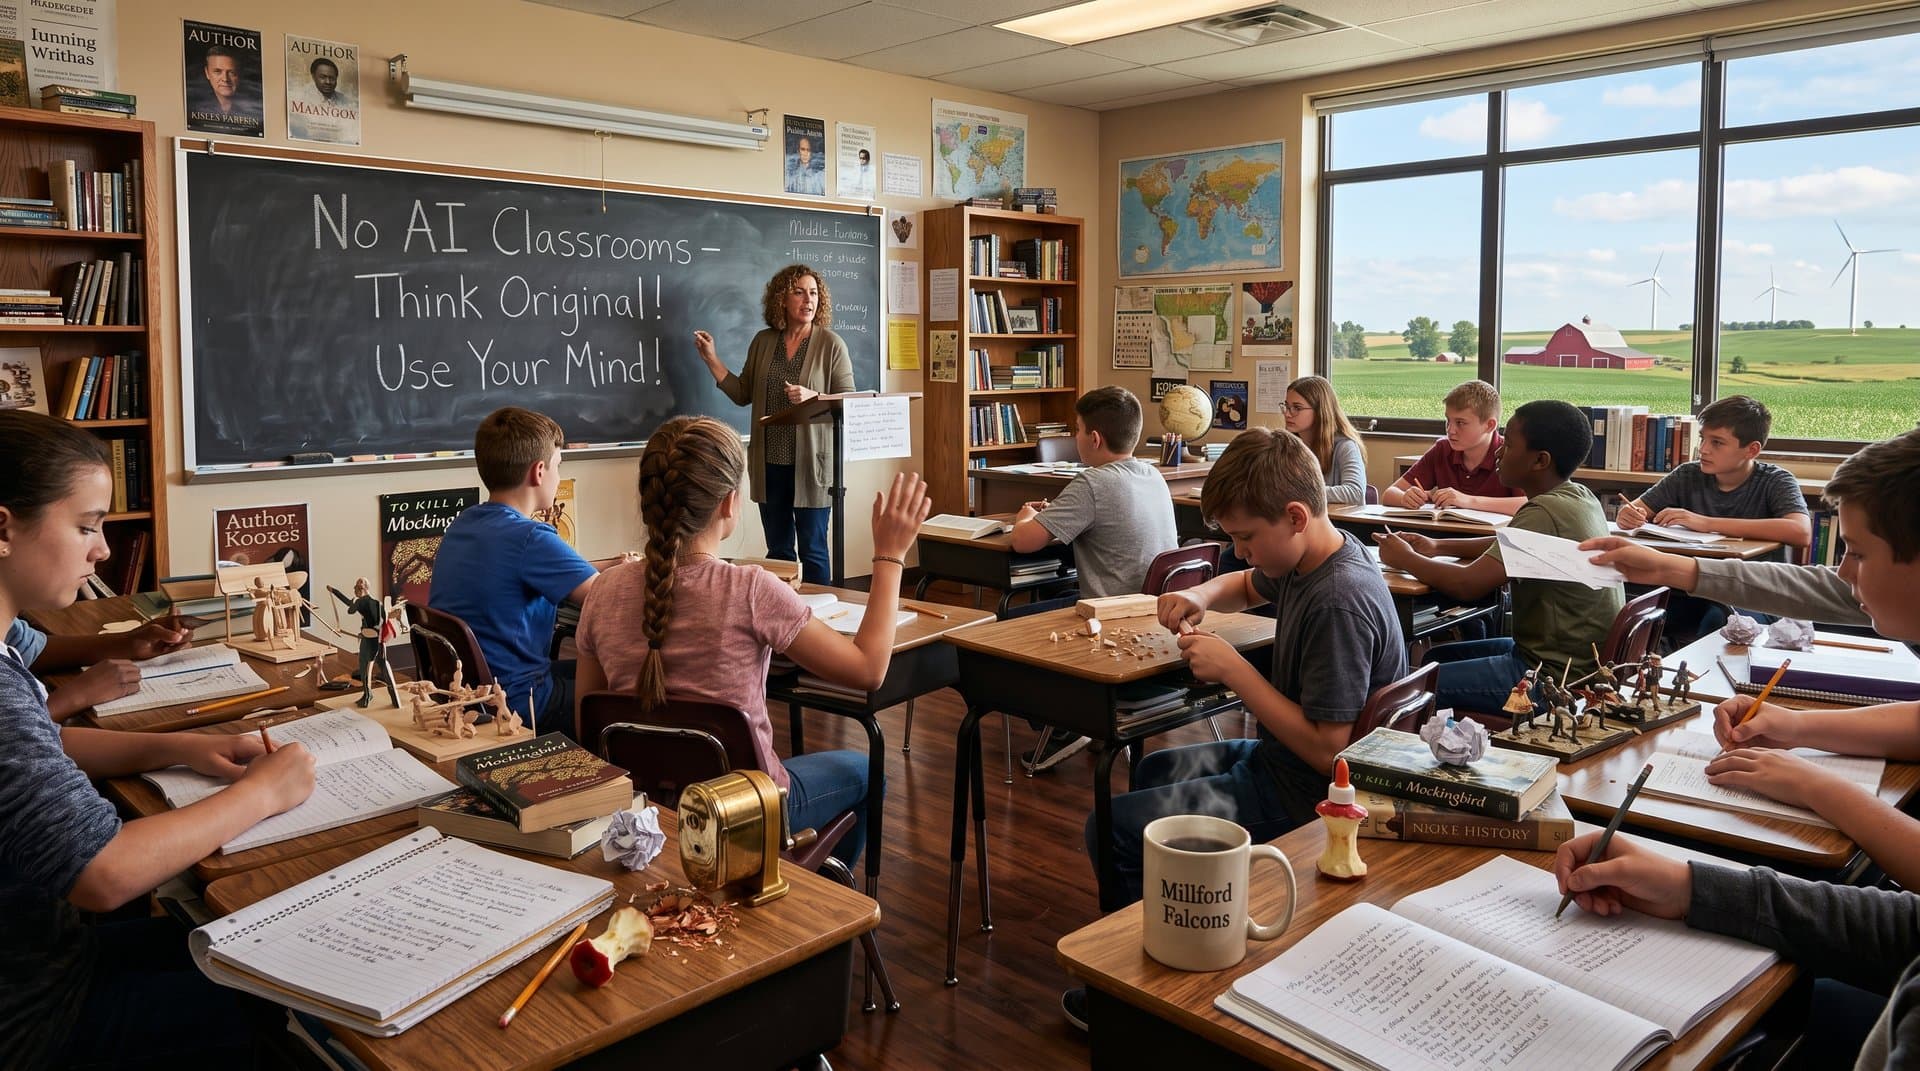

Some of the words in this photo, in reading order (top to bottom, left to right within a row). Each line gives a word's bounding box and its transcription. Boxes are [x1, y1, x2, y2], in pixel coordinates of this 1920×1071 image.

[188, 29, 257, 50] AUTHOR
[31, 45, 95, 66] Writhas
[291, 41, 355, 61] AUTHOR
[313, 193, 378, 249] No
[404, 199, 468, 254] AI
[789, 219, 829, 237] Middle
[822, 251, 833, 263] of
[354, 272, 483, 319] Think
[500, 273, 662, 337] Original!
[376, 343, 454, 391] Use
[467, 338, 550, 390] Your
[565, 337, 662, 388] Mind!
[389, 502, 409, 513] TO
[415, 498, 449, 510] KILL
[455, 497, 464, 507] A
[474, 754, 492, 763] TO
[499, 745, 537, 757] KILL
[476, 741, 568, 770] Mockingbird
[1365, 775, 1392, 787] KILL
[1394, 781, 1402, 790] A
[1405, 781, 1487, 807] Mockingbird
[1465, 825, 1530, 840] HISTORY
[1160, 879, 1232, 904] Millford
[1163, 904, 1230, 929] Falcons
